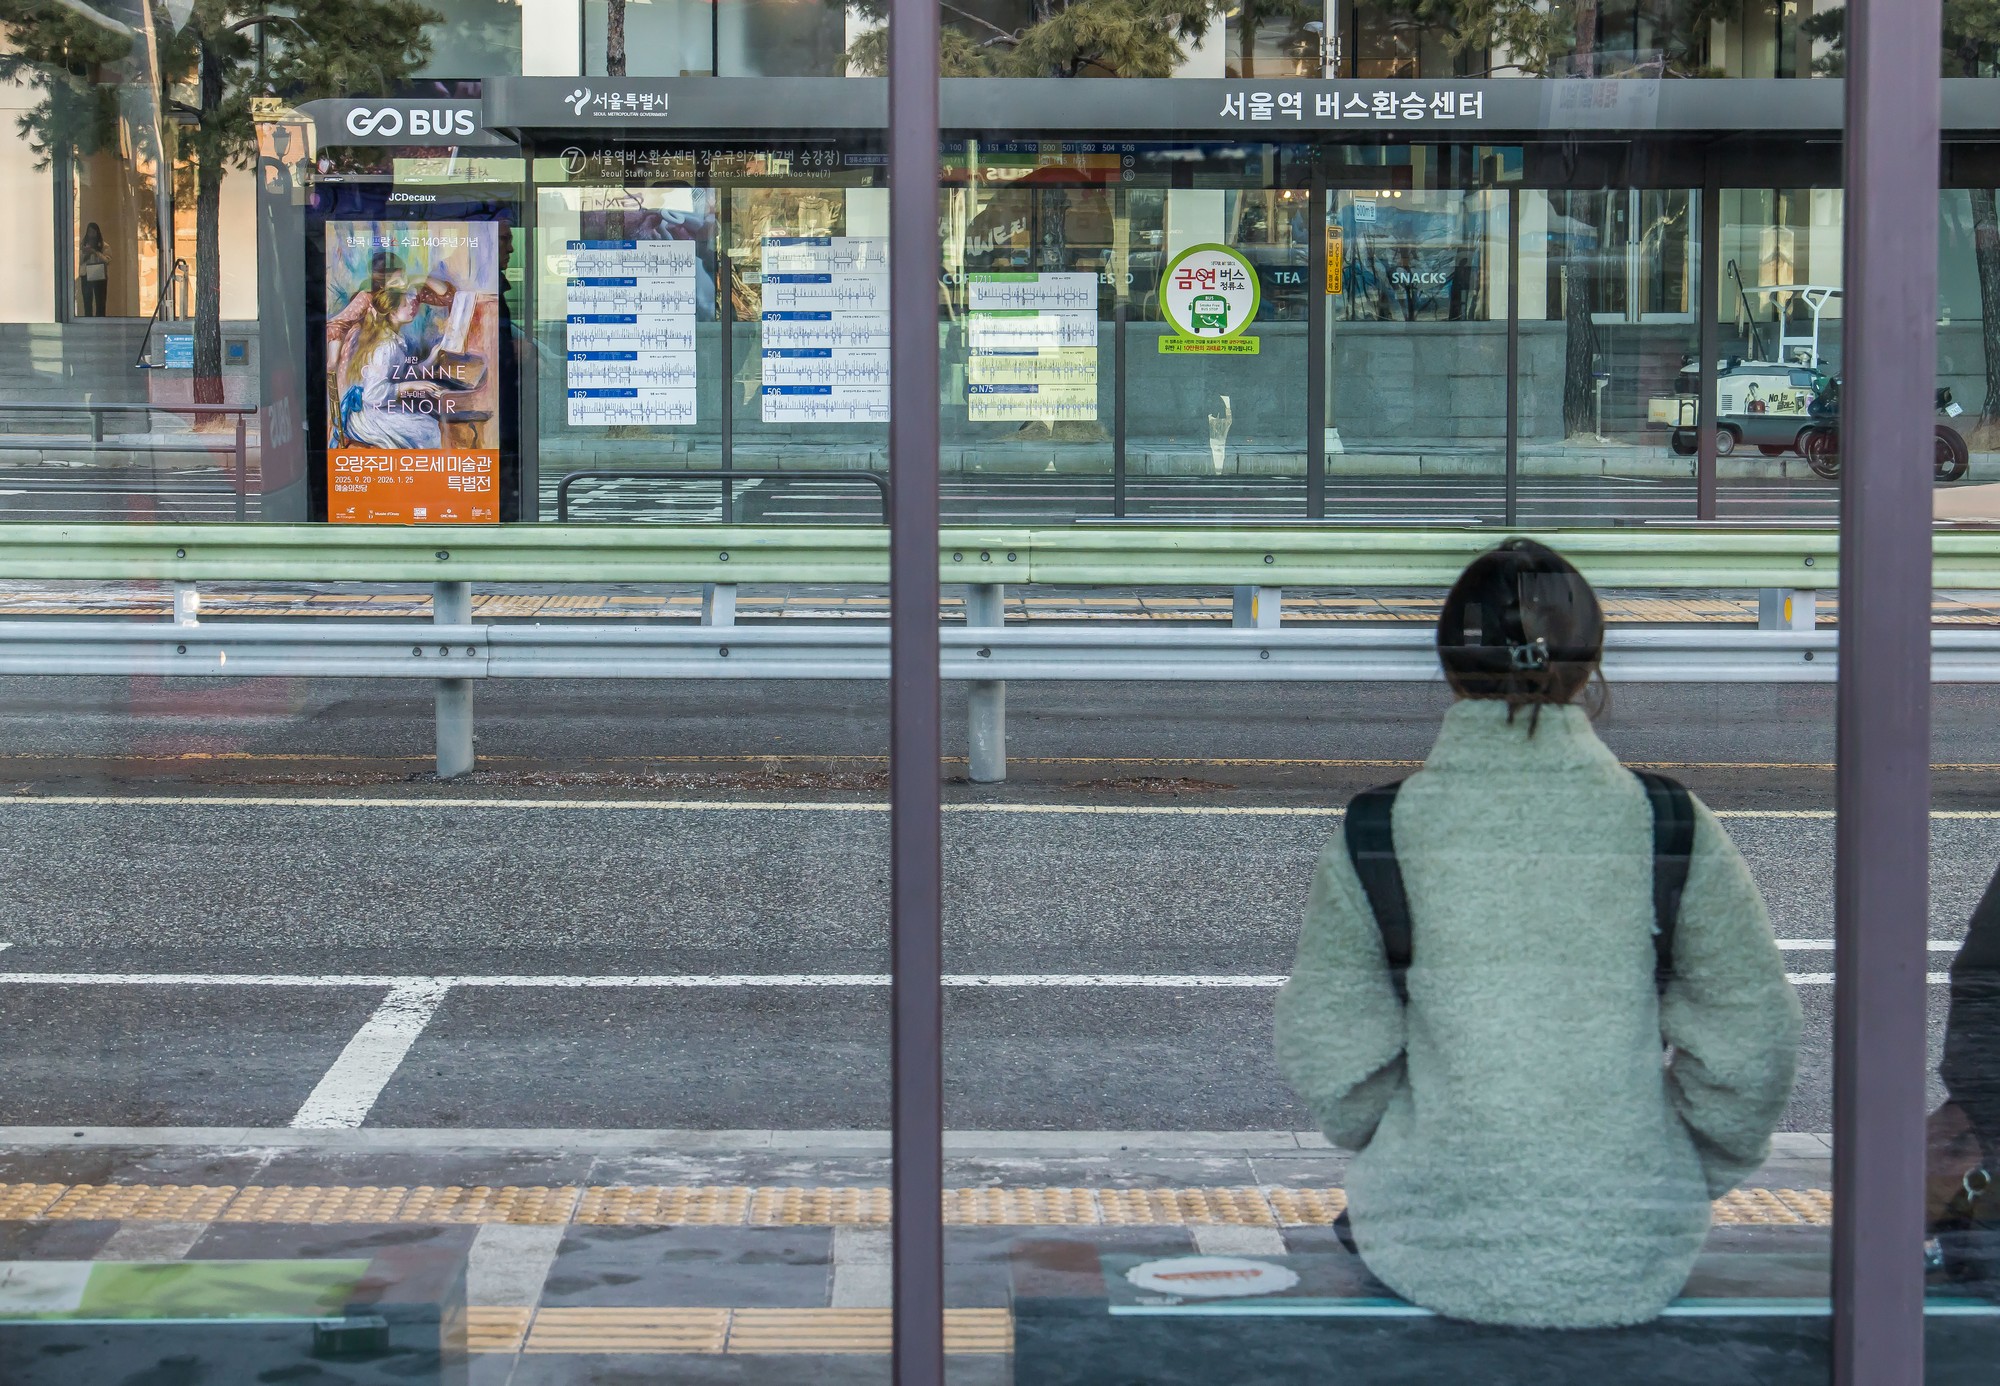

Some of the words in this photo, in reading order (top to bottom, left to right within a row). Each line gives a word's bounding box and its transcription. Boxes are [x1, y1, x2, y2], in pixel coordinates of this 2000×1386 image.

[593, 92, 669, 111] 서울특별시
[1219, 91, 1303, 121] 서울역
[1315, 91, 1484, 120] 버스환승센터
[347, 107, 403, 137] GO
[410, 109, 475, 136] BUS
[987, 144, 999, 152] 151
[1005, 144, 1018, 152] 152
[1024, 144, 1037, 152] 162
[1042, 144, 1056, 152] 500
[1062, 144, 1075, 152] 501
[1102, 144, 1115, 152] 504
[1122, 144, 1135, 152] 506
[800, 149, 840, 167] 승강장)
[601, 169, 622, 178] Seoul
[625, 169, 652, 178] Station
[656, 169, 669, 178] Bus
[673, 169, 705, 178] Transfer
[388, 192, 437, 202] JCDecaux
[346, 236, 366, 249] 한국
[401, 237, 420, 249] 수교
[421, 237, 458, 249] 140주년
[460, 237, 479, 249] 기념
[1175, 268, 1216, 290] 금연
[1220, 268, 1245, 281] 버스
[1275, 272, 1301, 284] TEA
[1391, 272, 1447, 284] SNACKS
[1220, 281, 1245, 291] 정류소
[372, 399, 456, 414] RENOIR
[335, 456, 393, 473] 오랑주리
[399, 456, 444, 473] 오르세
[447, 456, 492, 473] 미술관
[335, 476, 352, 484] 2025.
[377, 476, 395, 484] 2026.
[405, 476, 414, 484] 25
[448, 475, 491, 492] 특별전
[335, 484, 368, 492] 예술의전당
